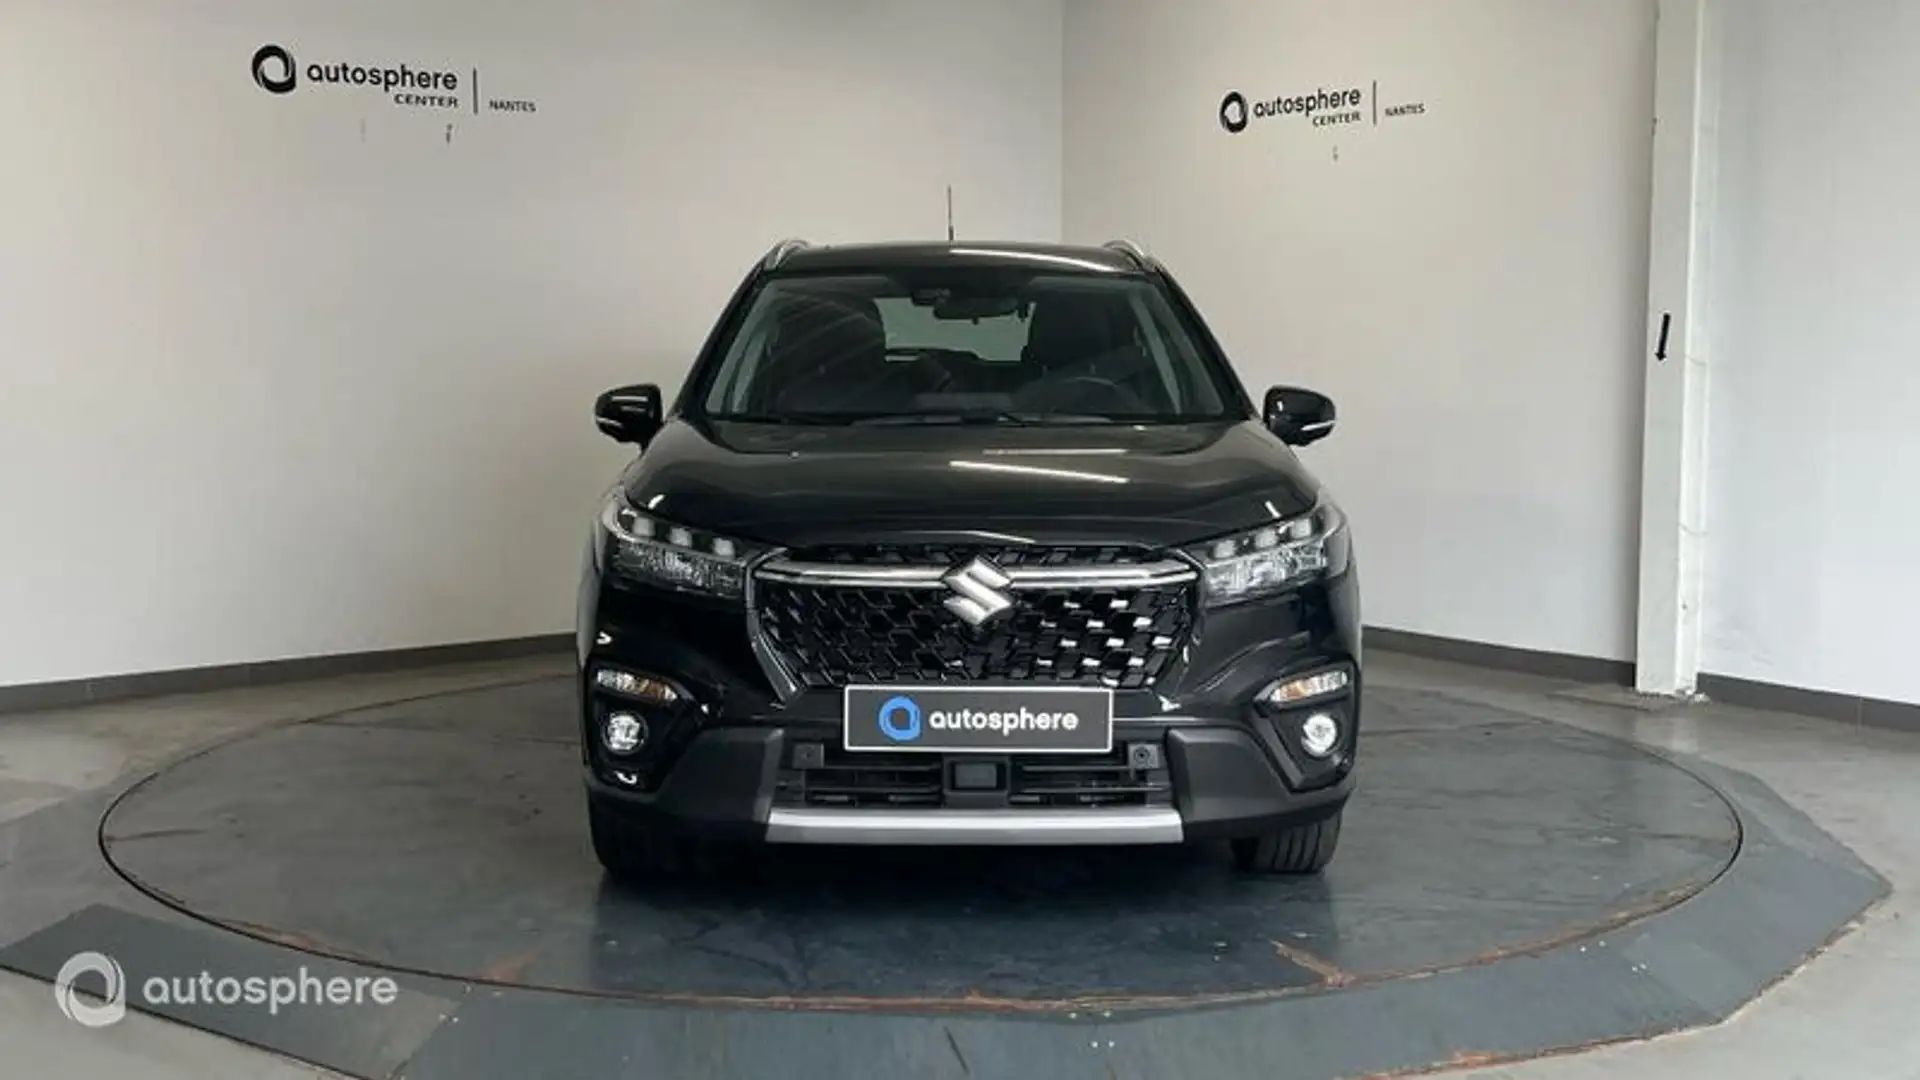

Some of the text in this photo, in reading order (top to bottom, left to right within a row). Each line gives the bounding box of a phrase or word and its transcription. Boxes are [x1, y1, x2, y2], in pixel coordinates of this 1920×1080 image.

[306, 62, 458, 92] autosphere
[394, 93, 459, 109] CENTER
[488, 99, 537, 113] NANTES
[1253, 88, 1361, 116] autosphere
[1384, 103, 1426, 117] NANTES
[1312, 111, 1362, 127] CENTER
[928, 706, 1079, 736] autosphere
